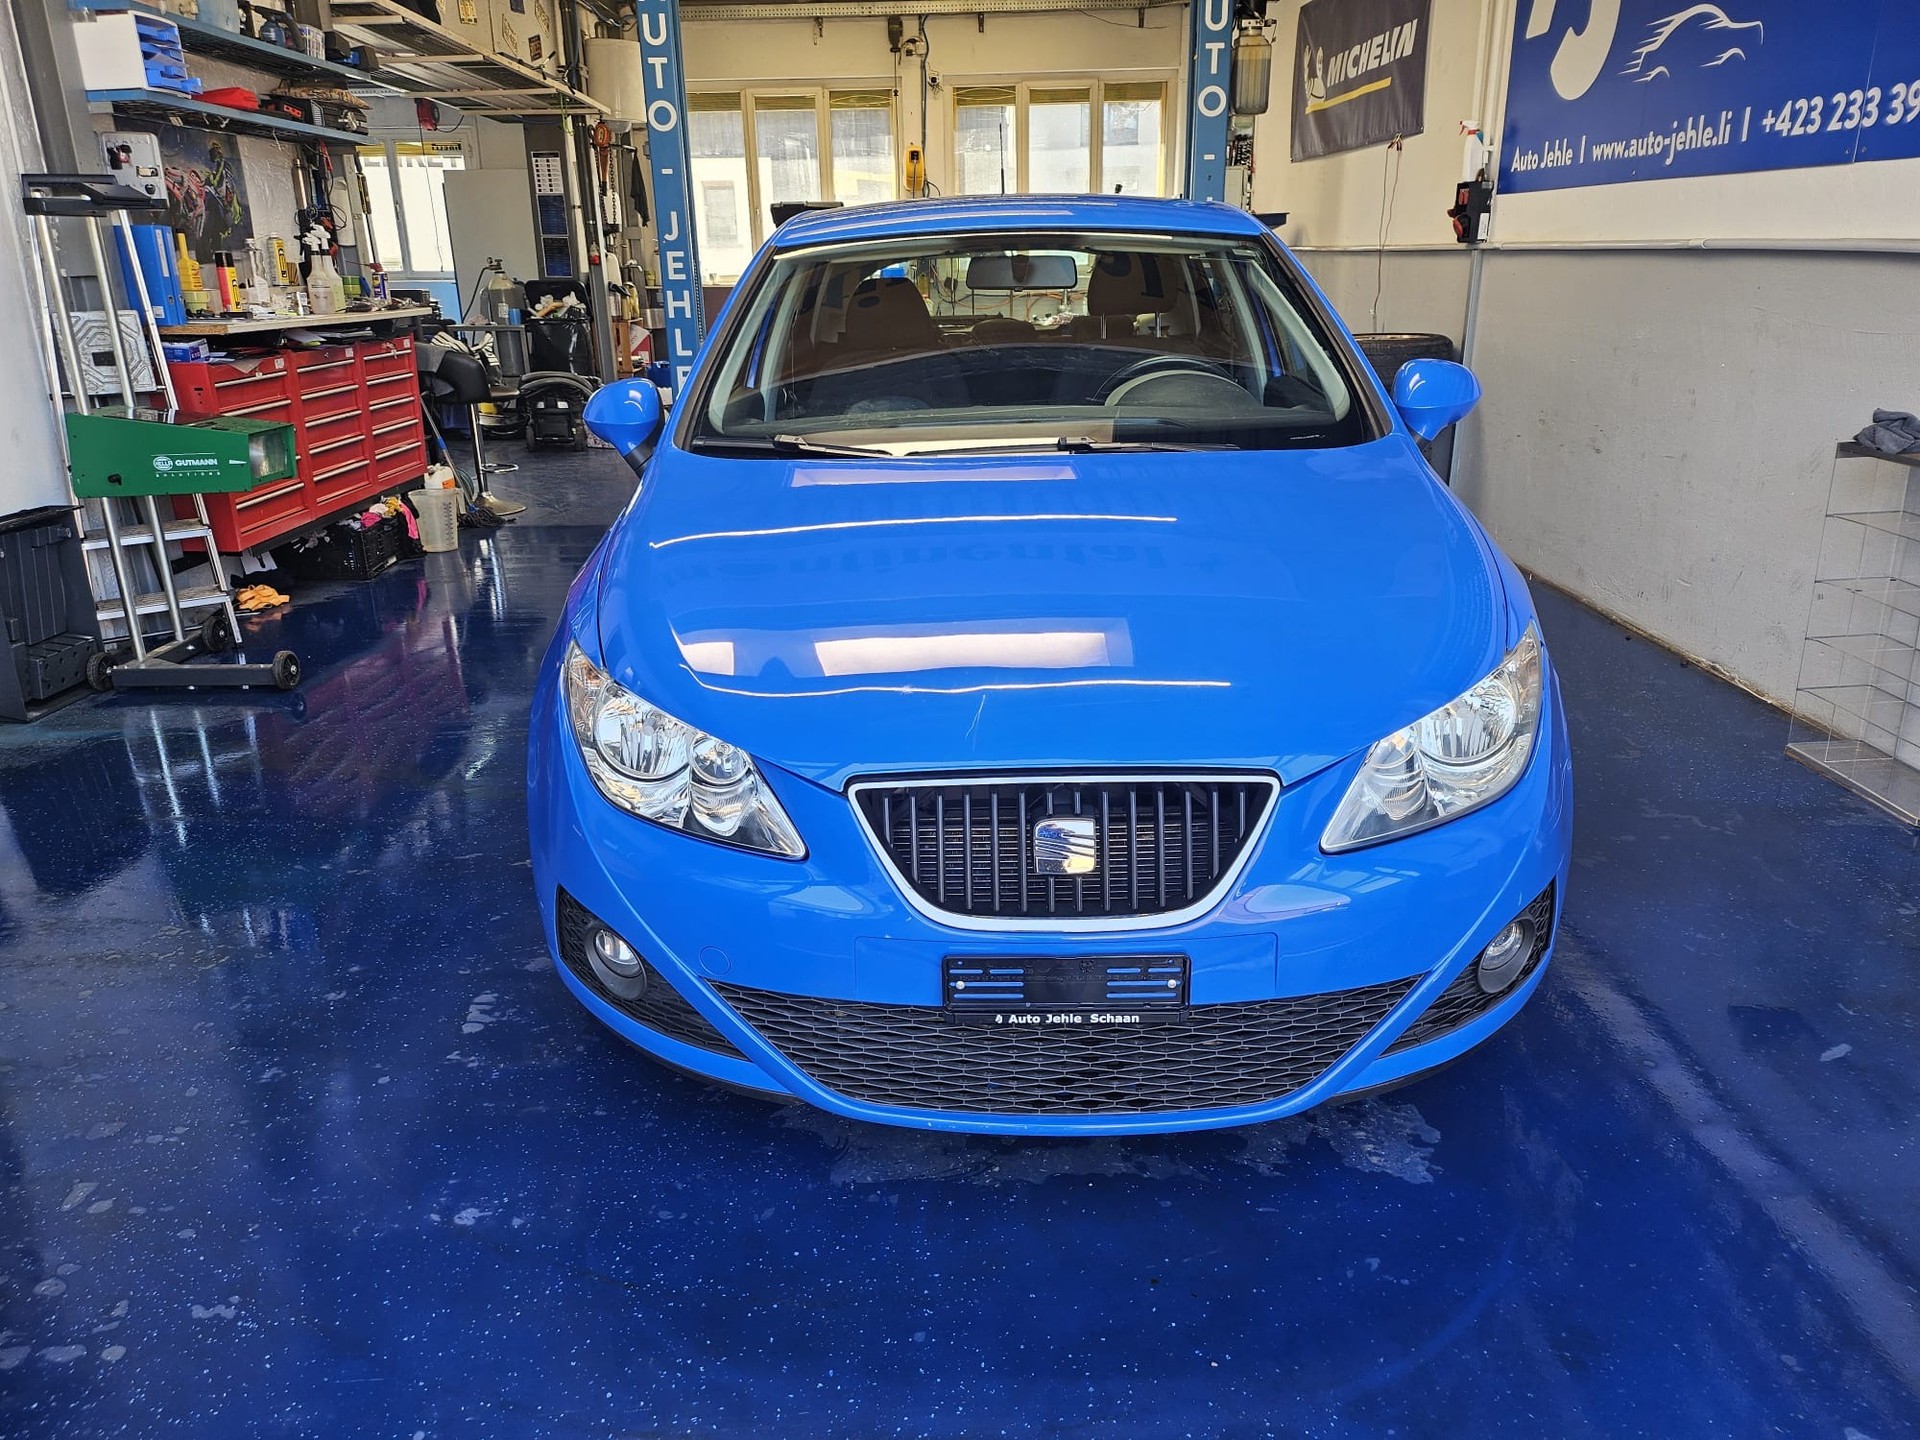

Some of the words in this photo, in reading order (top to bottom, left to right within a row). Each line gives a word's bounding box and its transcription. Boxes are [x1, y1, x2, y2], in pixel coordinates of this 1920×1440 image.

[639, 0, 677, 132] UTO
[1327, 18, 1418, 88] MICHELIN
[1511, 146, 1538, 172] Auto
[1540, 138, 1573, 168] Jehle
[1592, 110, 1733, 165] www.auto-jehle.li
[1762, 96, 1824, 137] +423
[1826, 86, 1882, 131] 233
[175, 459, 218, 467] GUTMANN
[1008, 1014, 1041, 1023] Auto
[1045, 1013, 1082, 1023] Jehle
[1090, 1013, 1140, 1023] Schaan
